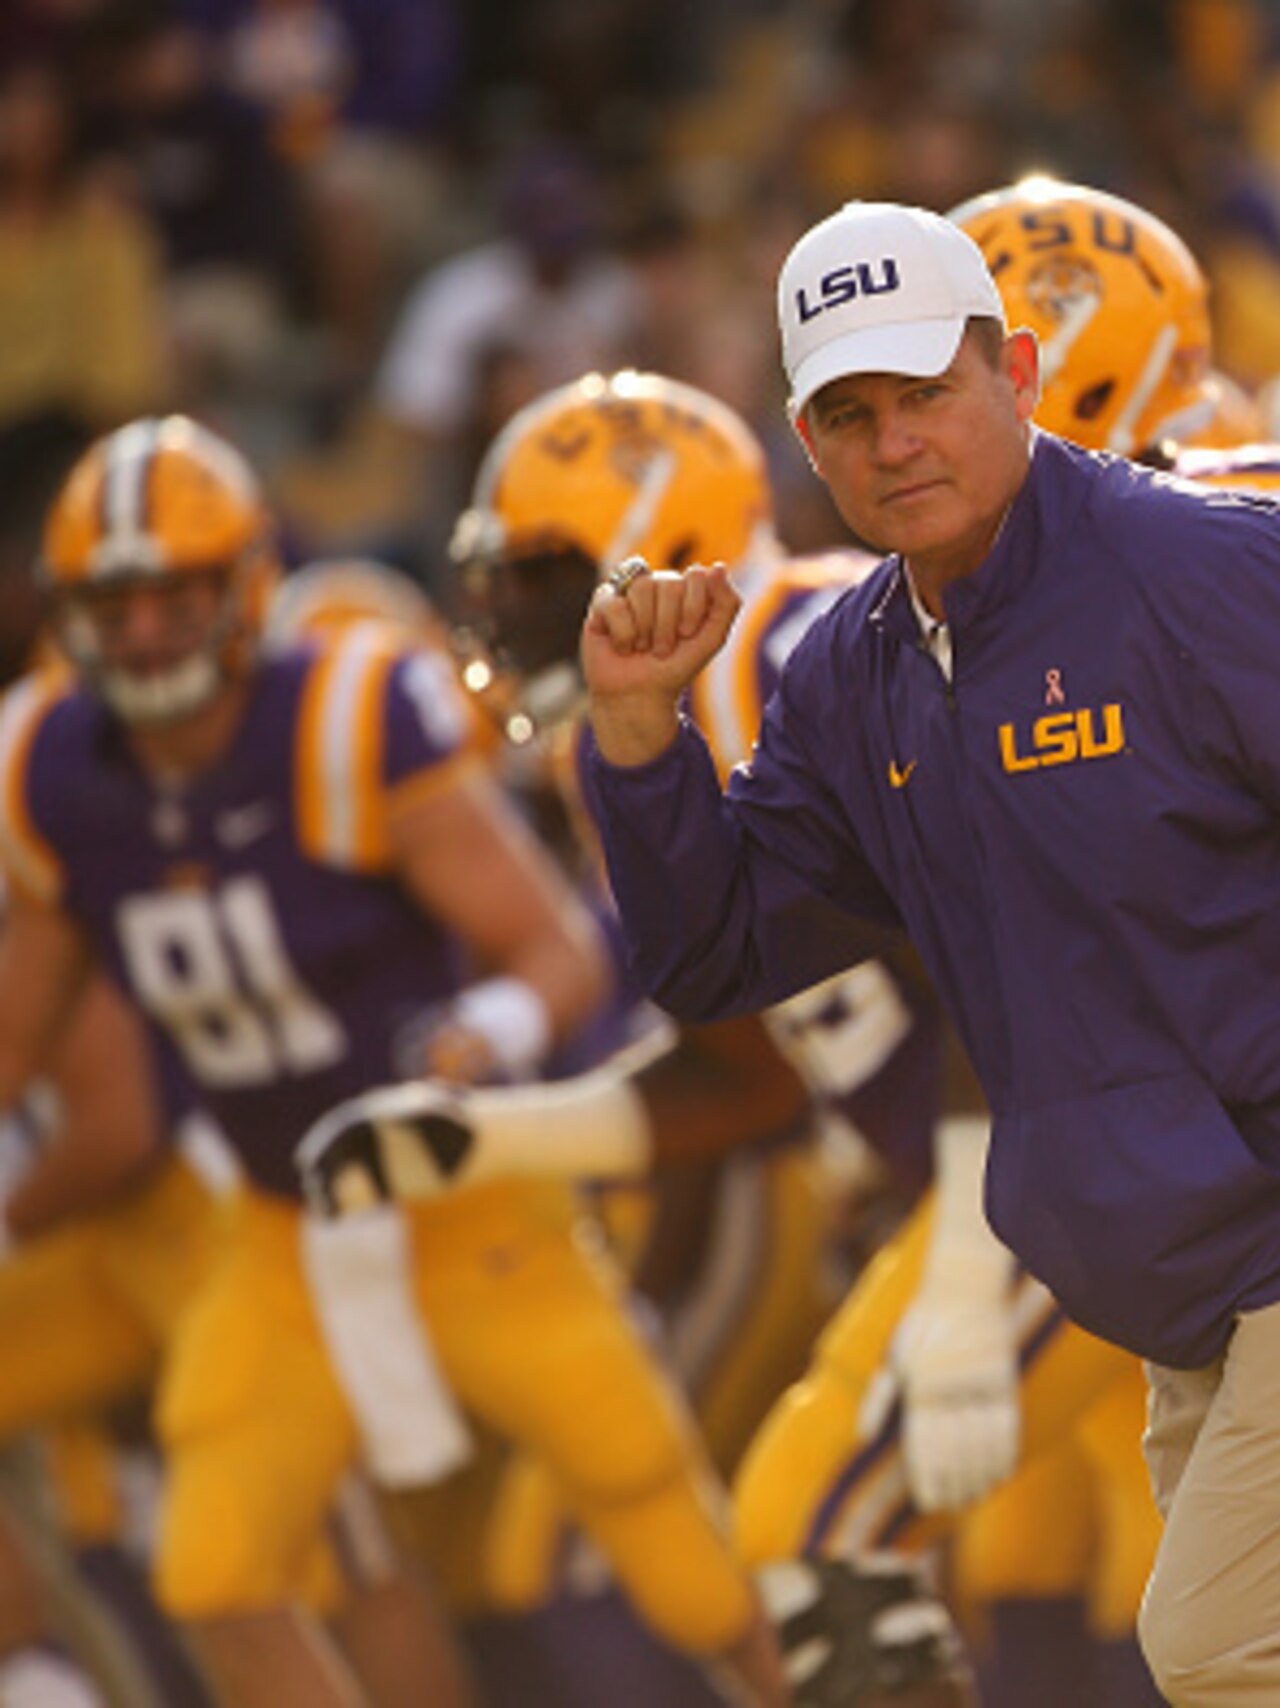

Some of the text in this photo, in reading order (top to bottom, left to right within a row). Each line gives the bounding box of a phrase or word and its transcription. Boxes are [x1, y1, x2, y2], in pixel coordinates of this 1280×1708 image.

[796, 259, 899, 325] LSU
[999, 703, 1125, 774] LSU
[115, 875, 348, 1089] 81
